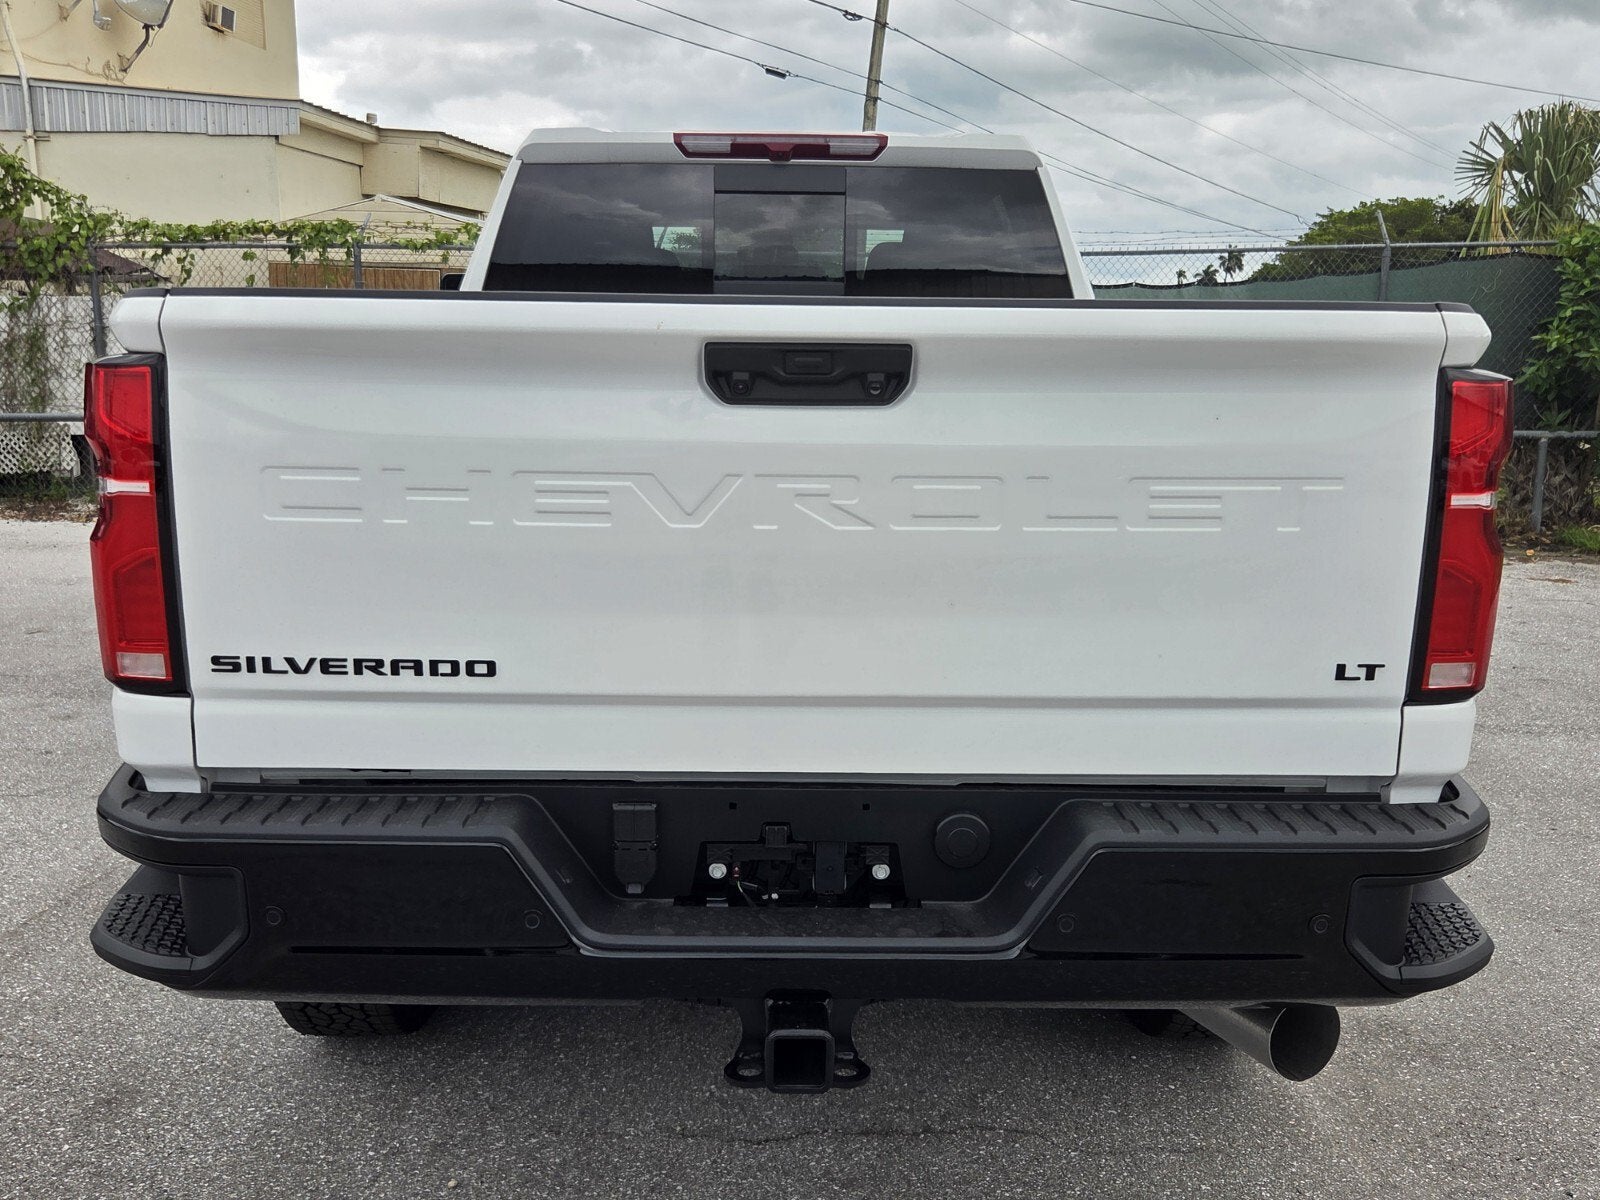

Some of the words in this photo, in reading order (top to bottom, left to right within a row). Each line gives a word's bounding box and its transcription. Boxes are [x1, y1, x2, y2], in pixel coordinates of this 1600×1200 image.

[261, 466, 1345, 532] CHEVROLET
[210, 655, 497, 678] SILVERADO
[1334, 663, 1386, 682] LT
